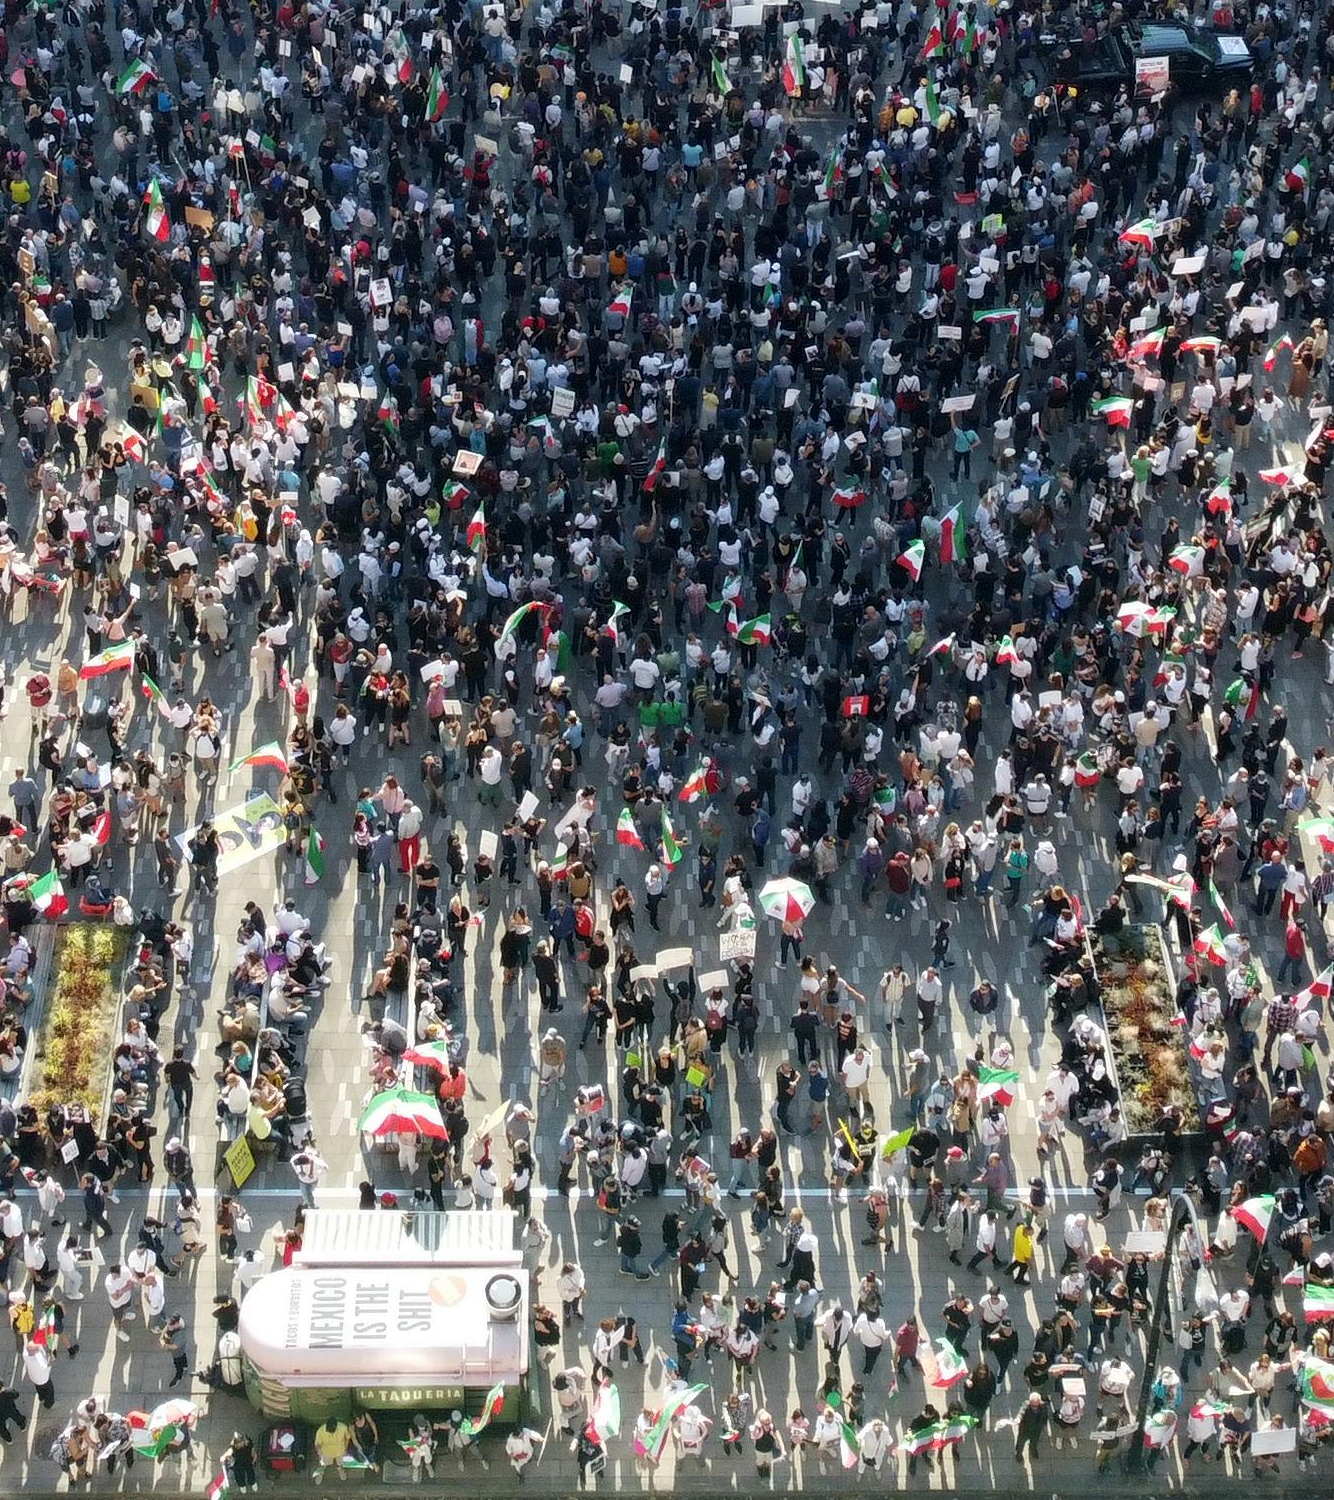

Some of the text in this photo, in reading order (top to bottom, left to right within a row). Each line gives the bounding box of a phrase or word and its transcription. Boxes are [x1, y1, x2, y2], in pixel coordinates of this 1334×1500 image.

[289, 1279, 302, 1315] BURRITOS
[309, 1277, 347, 1349] MEXICO
[353, 1283, 390, 1340] IS THE
[397, 1290, 432, 1331] SHIT
[285, 1323, 299, 1349] TACOS
[360, 1389, 462, 1401] LA TAQUERIA
